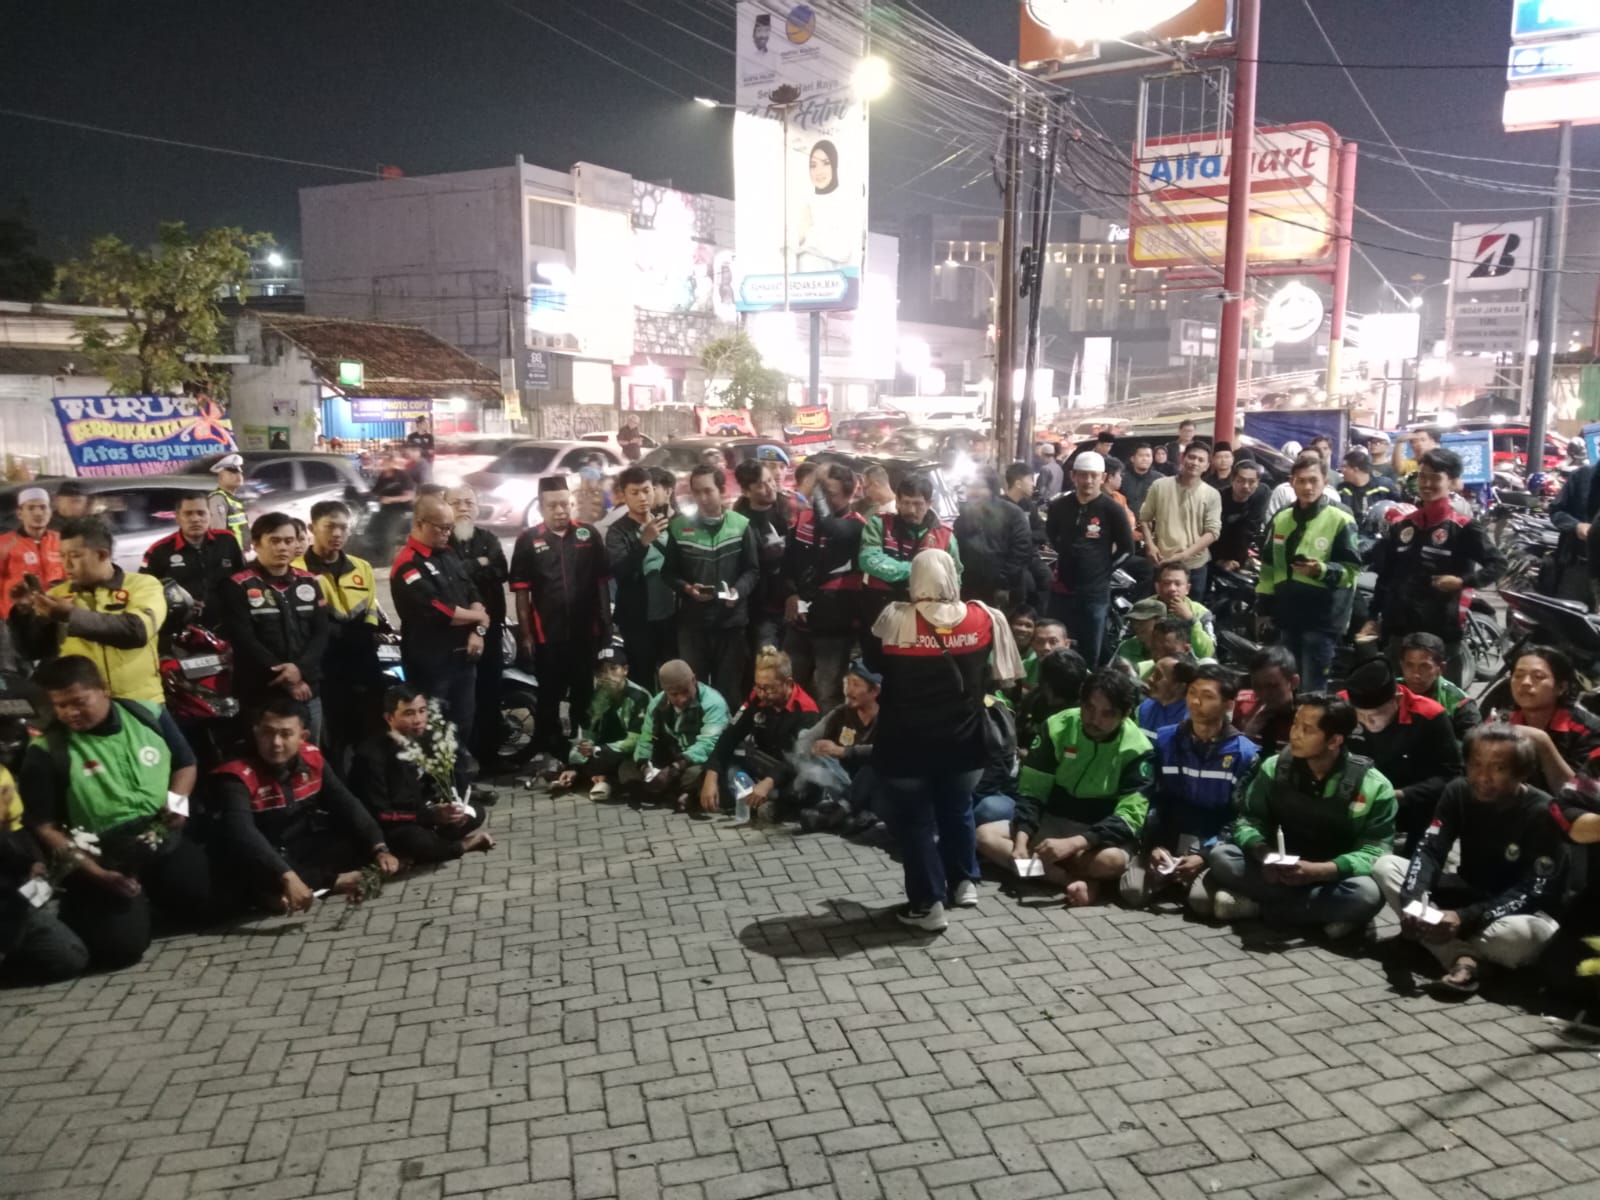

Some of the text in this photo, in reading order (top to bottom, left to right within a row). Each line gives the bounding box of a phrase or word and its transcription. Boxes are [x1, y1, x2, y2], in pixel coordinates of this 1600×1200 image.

[1150, 141, 1318, 182] Alfaart
[58, 396, 198, 422] TURUT
[82, 443, 225, 463] Atas Gugurnya
[915, 632, 978, 648] POOL LAMPUNG
